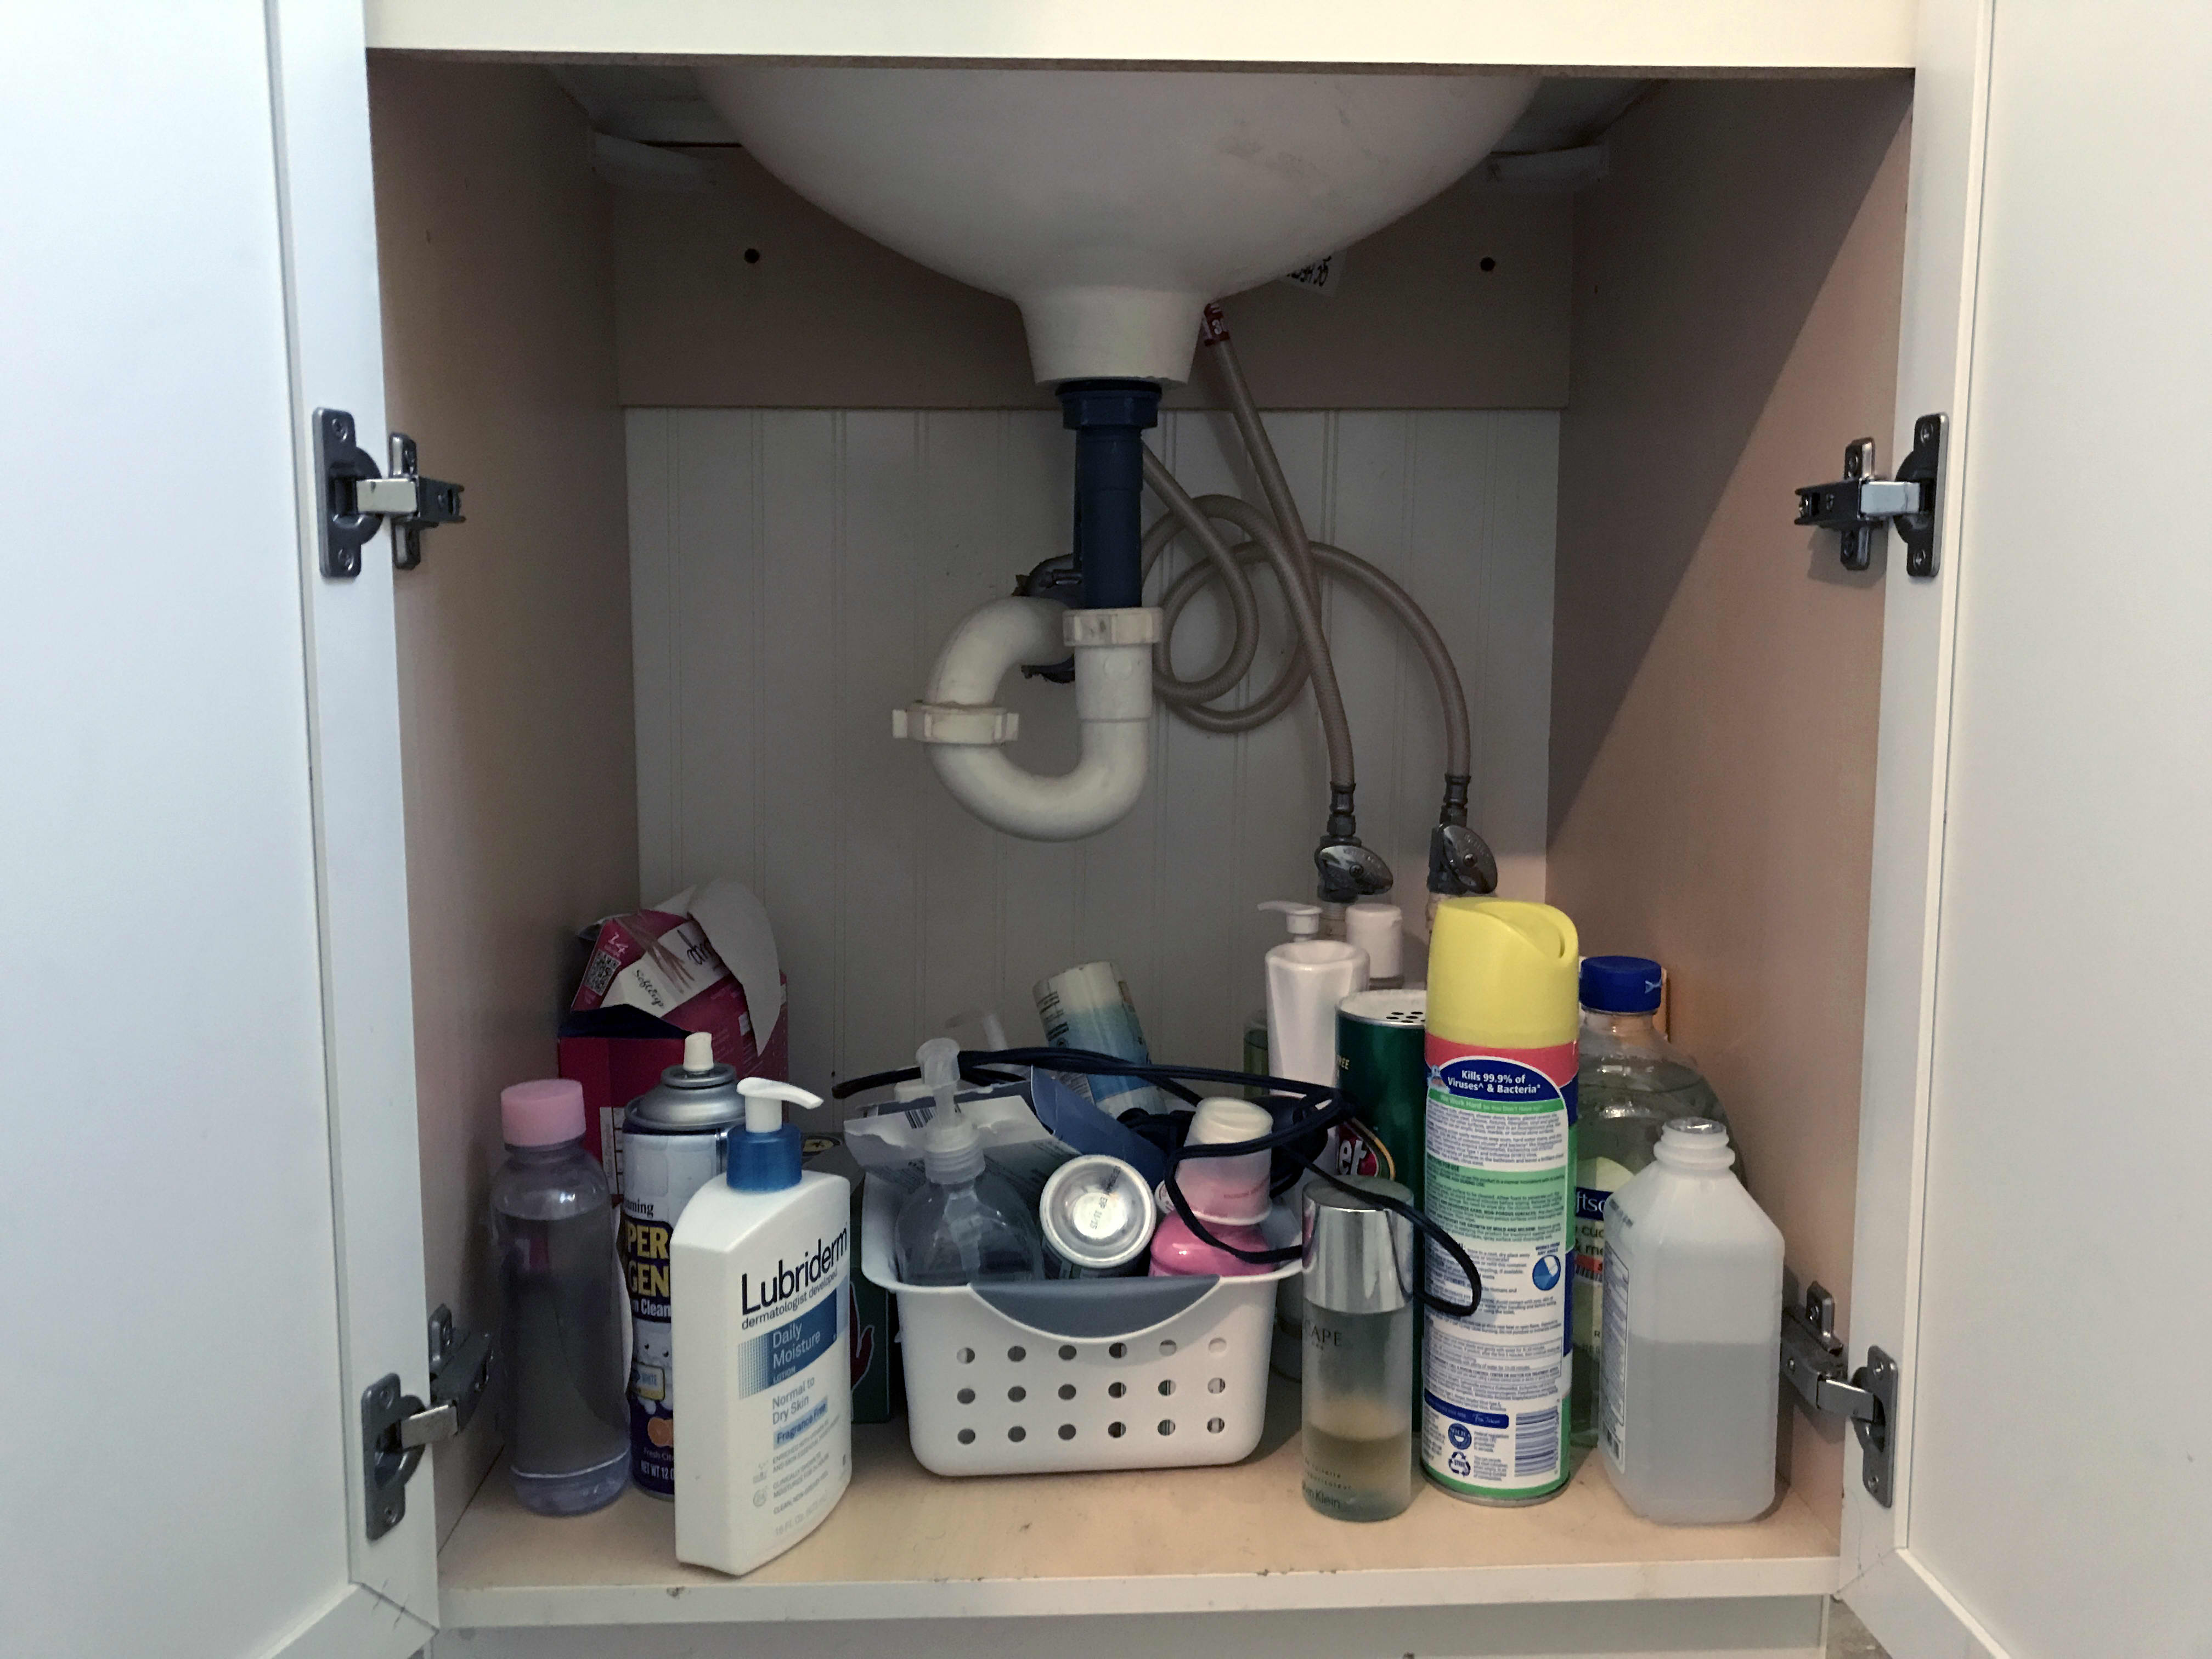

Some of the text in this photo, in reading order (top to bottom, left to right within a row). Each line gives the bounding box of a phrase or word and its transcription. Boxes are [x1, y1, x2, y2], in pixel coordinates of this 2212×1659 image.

[1461, 1070, 1526, 1085] Kills 99.9% of
[1486, 1083, 1494, 1093] &
[1338, 1139, 1367, 1176] et
[742, 1227, 848, 1316] Lubriderm
[741, 1267, 838, 1330] dermatologist developed
[772, 1323, 803, 1349] Daily
[772, 1329, 821, 1369] Moisture
[772, 1367, 796, 1384] LOTION
[772, 1376, 815, 1410] Normal to
[772, 1396, 809, 1425] Dry Skin
[777, 1412, 814, 1443] Fragrance
[814, 1403, 826, 1420] Free
[1315, 1488, 1341, 1509] Klein
